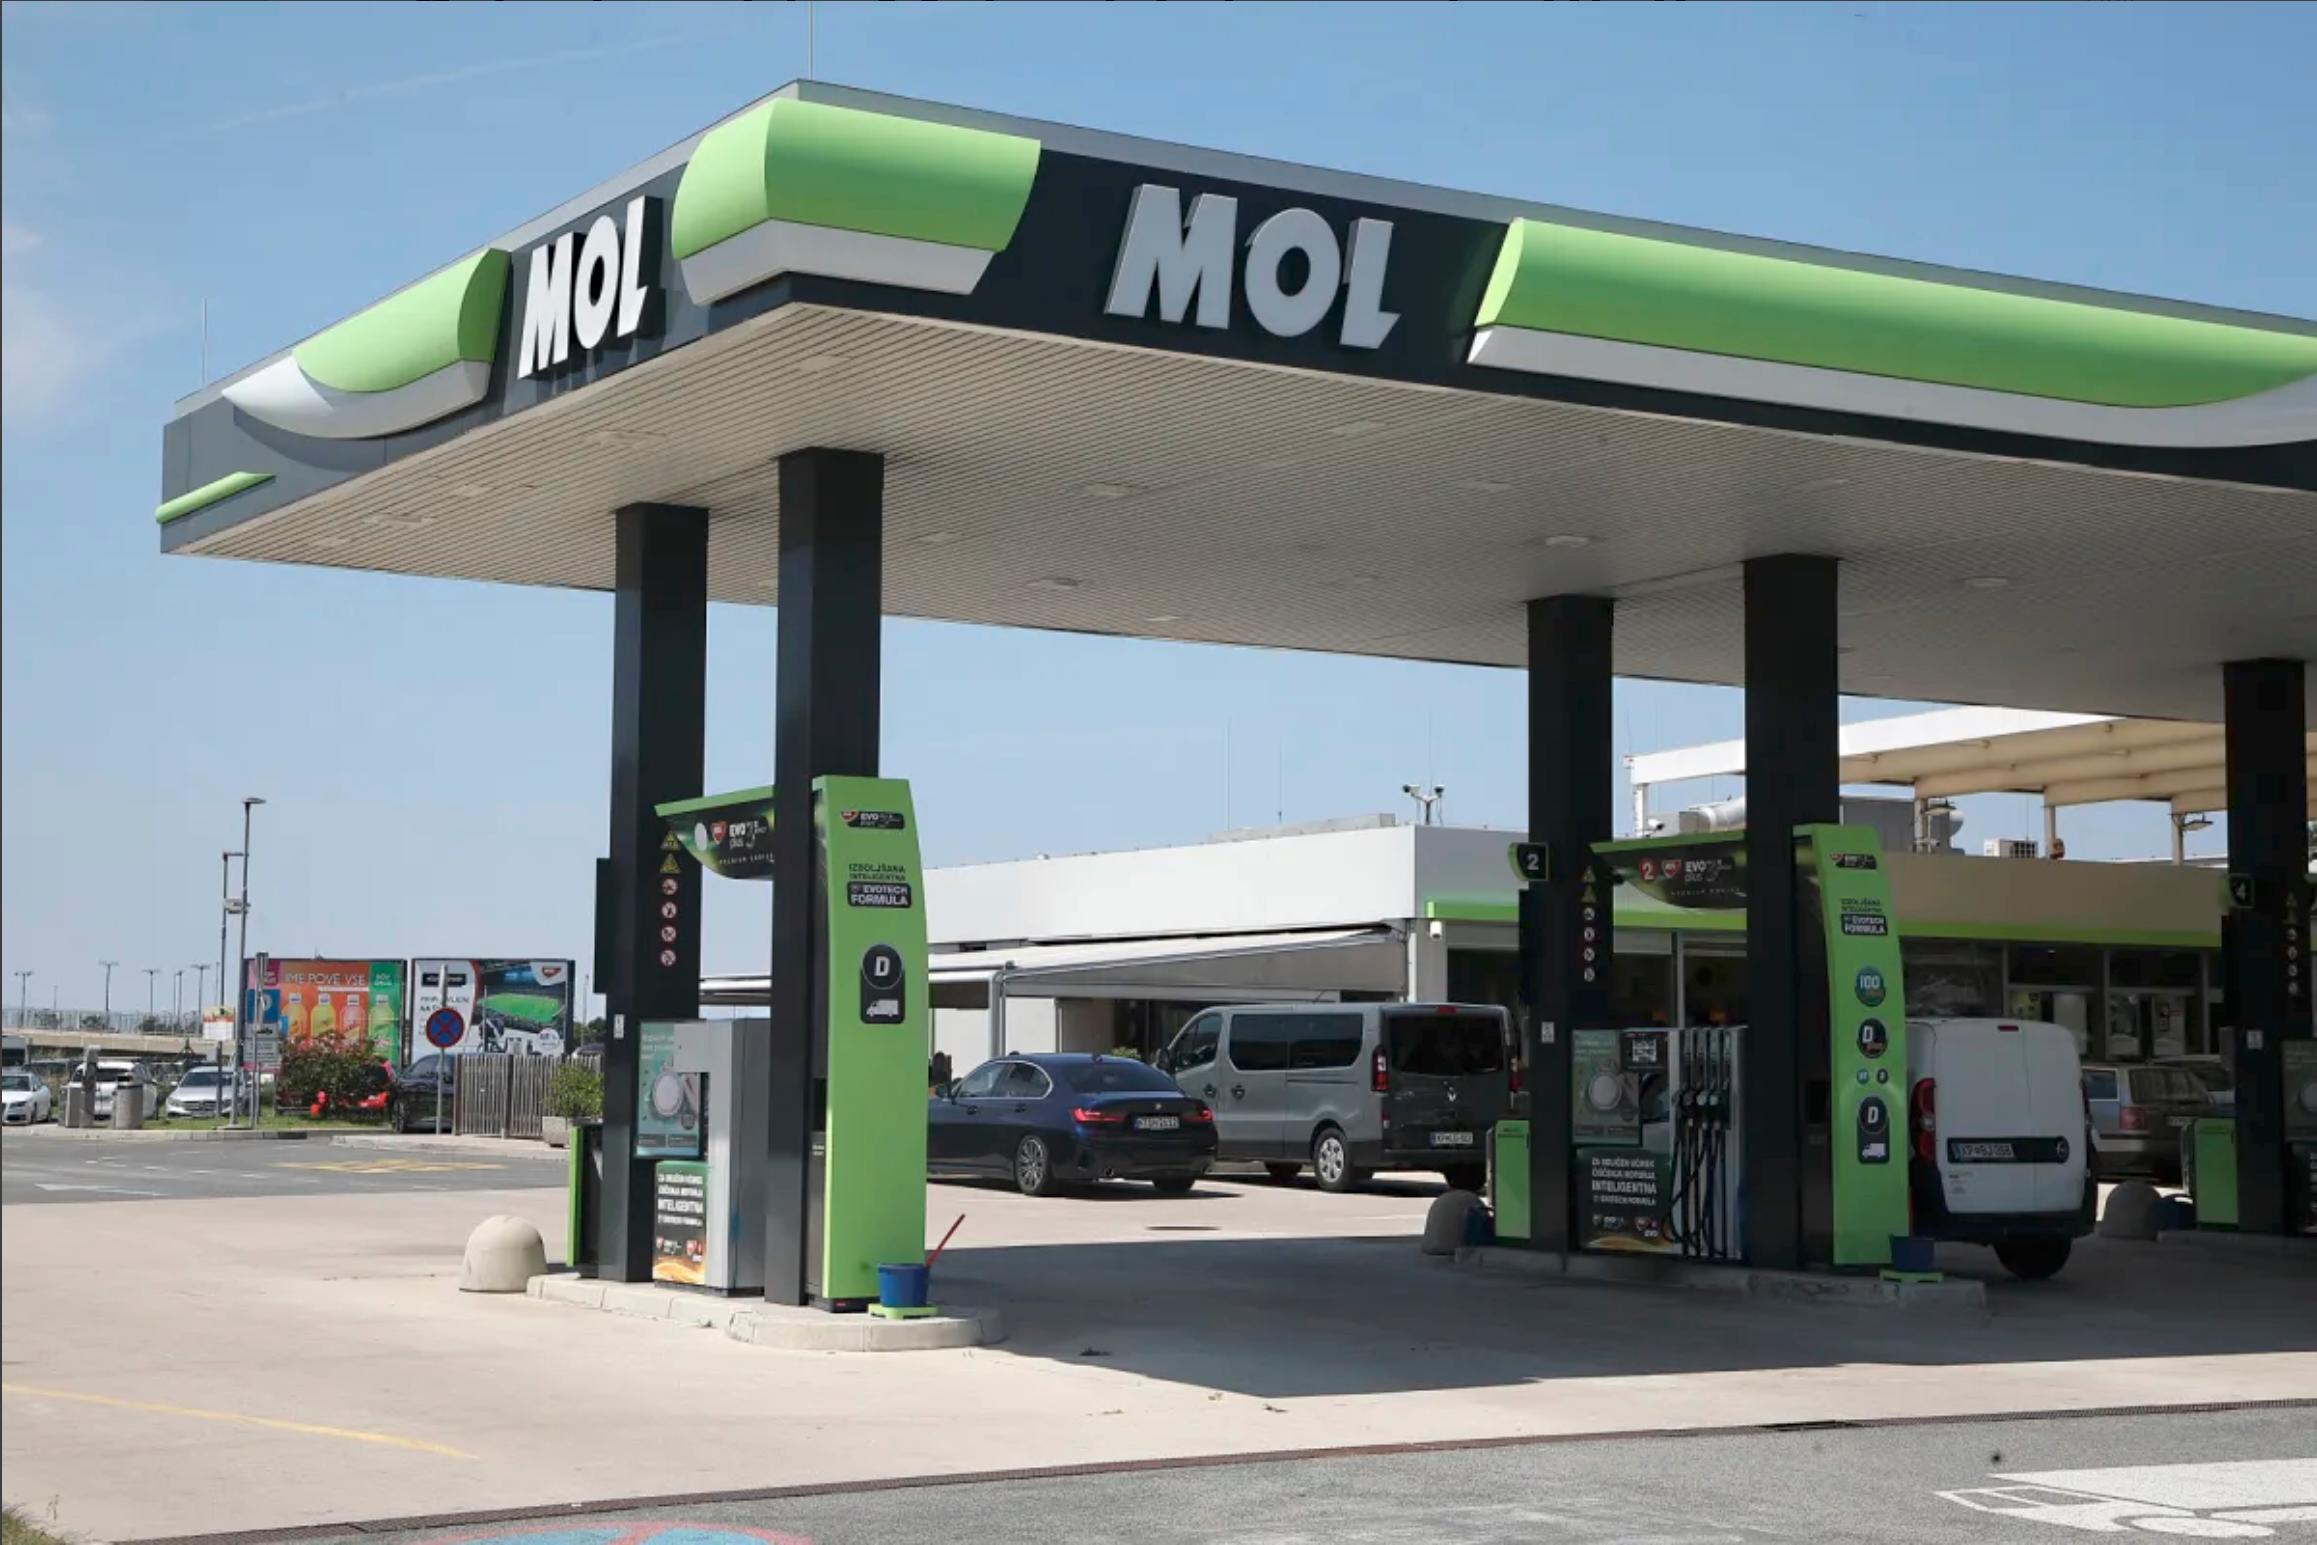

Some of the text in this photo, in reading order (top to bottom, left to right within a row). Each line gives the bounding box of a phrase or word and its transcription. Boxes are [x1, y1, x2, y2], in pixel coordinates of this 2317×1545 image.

[1103, 183, 1401, 350] MOL
[517, 195, 649, 380] MOL
[729, 822, 746, 838] EVO
[1527, 854, 1539, 871] 2
[1685, 860, 1706, 873] EVO
[1643, 862, 1654, 880] 2
[863, 883, 908, 895] EVOTECH
[850, 893, 909, 906] FORMULA
[874, 955, 891, 977] D
[345, 975, 366, 986] VSE
[1859, 974, 1881, 990] 100
[1862, 1026, 1874, 1043] D
[1867, 1106, 1879, 1124] D
[1592, 1180, 1656, 1194] INTELIGENTNA
